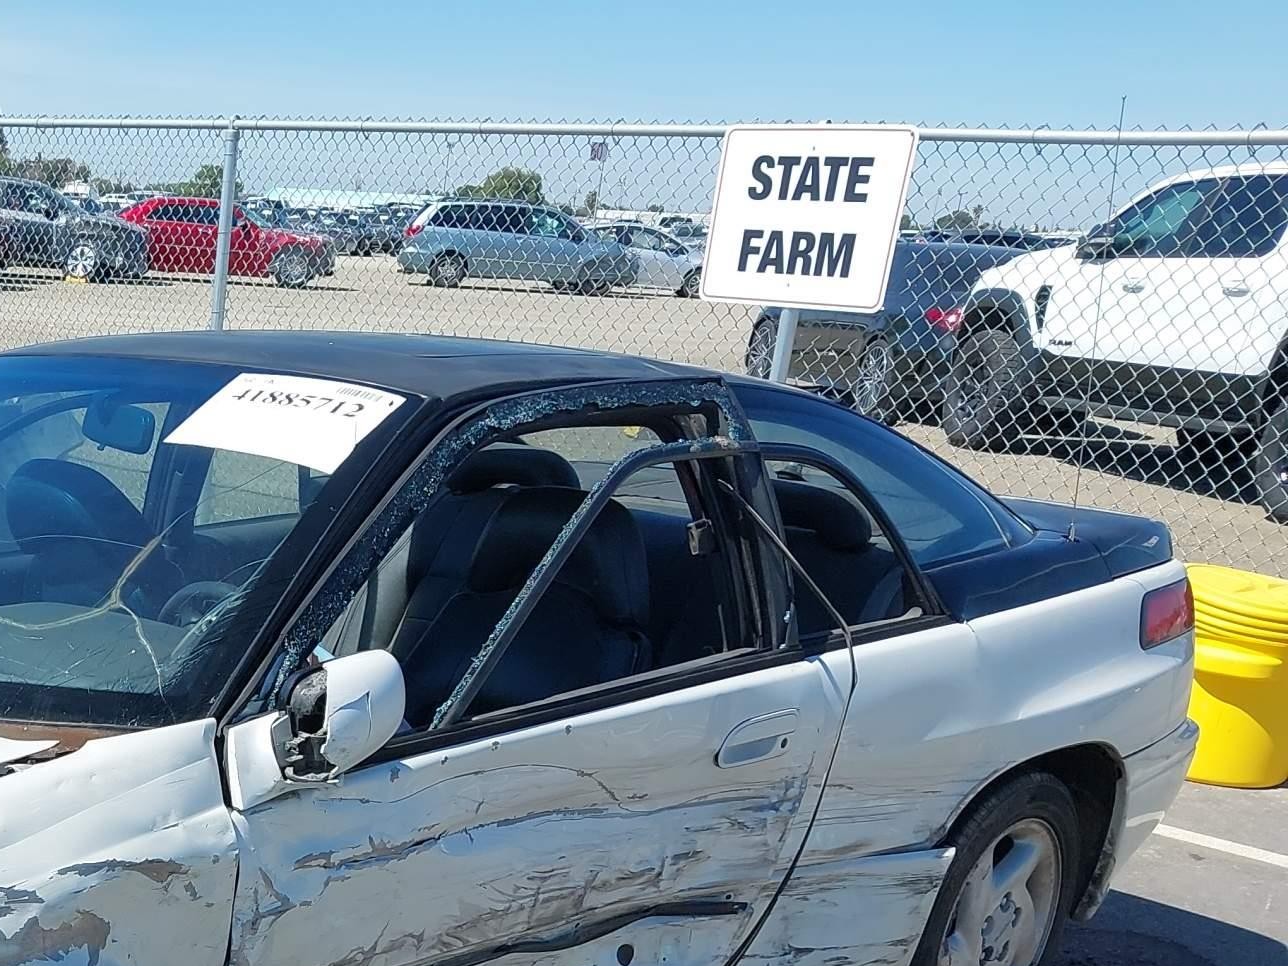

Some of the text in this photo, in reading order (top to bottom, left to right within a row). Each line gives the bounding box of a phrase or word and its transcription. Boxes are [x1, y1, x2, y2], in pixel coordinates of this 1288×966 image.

[747, 154, 876, 203] STATE
[737, 228, 858, 279] FARM
[1048, 339, 1073, 347] RAM
[231, 388, 366, 418] 41885712
